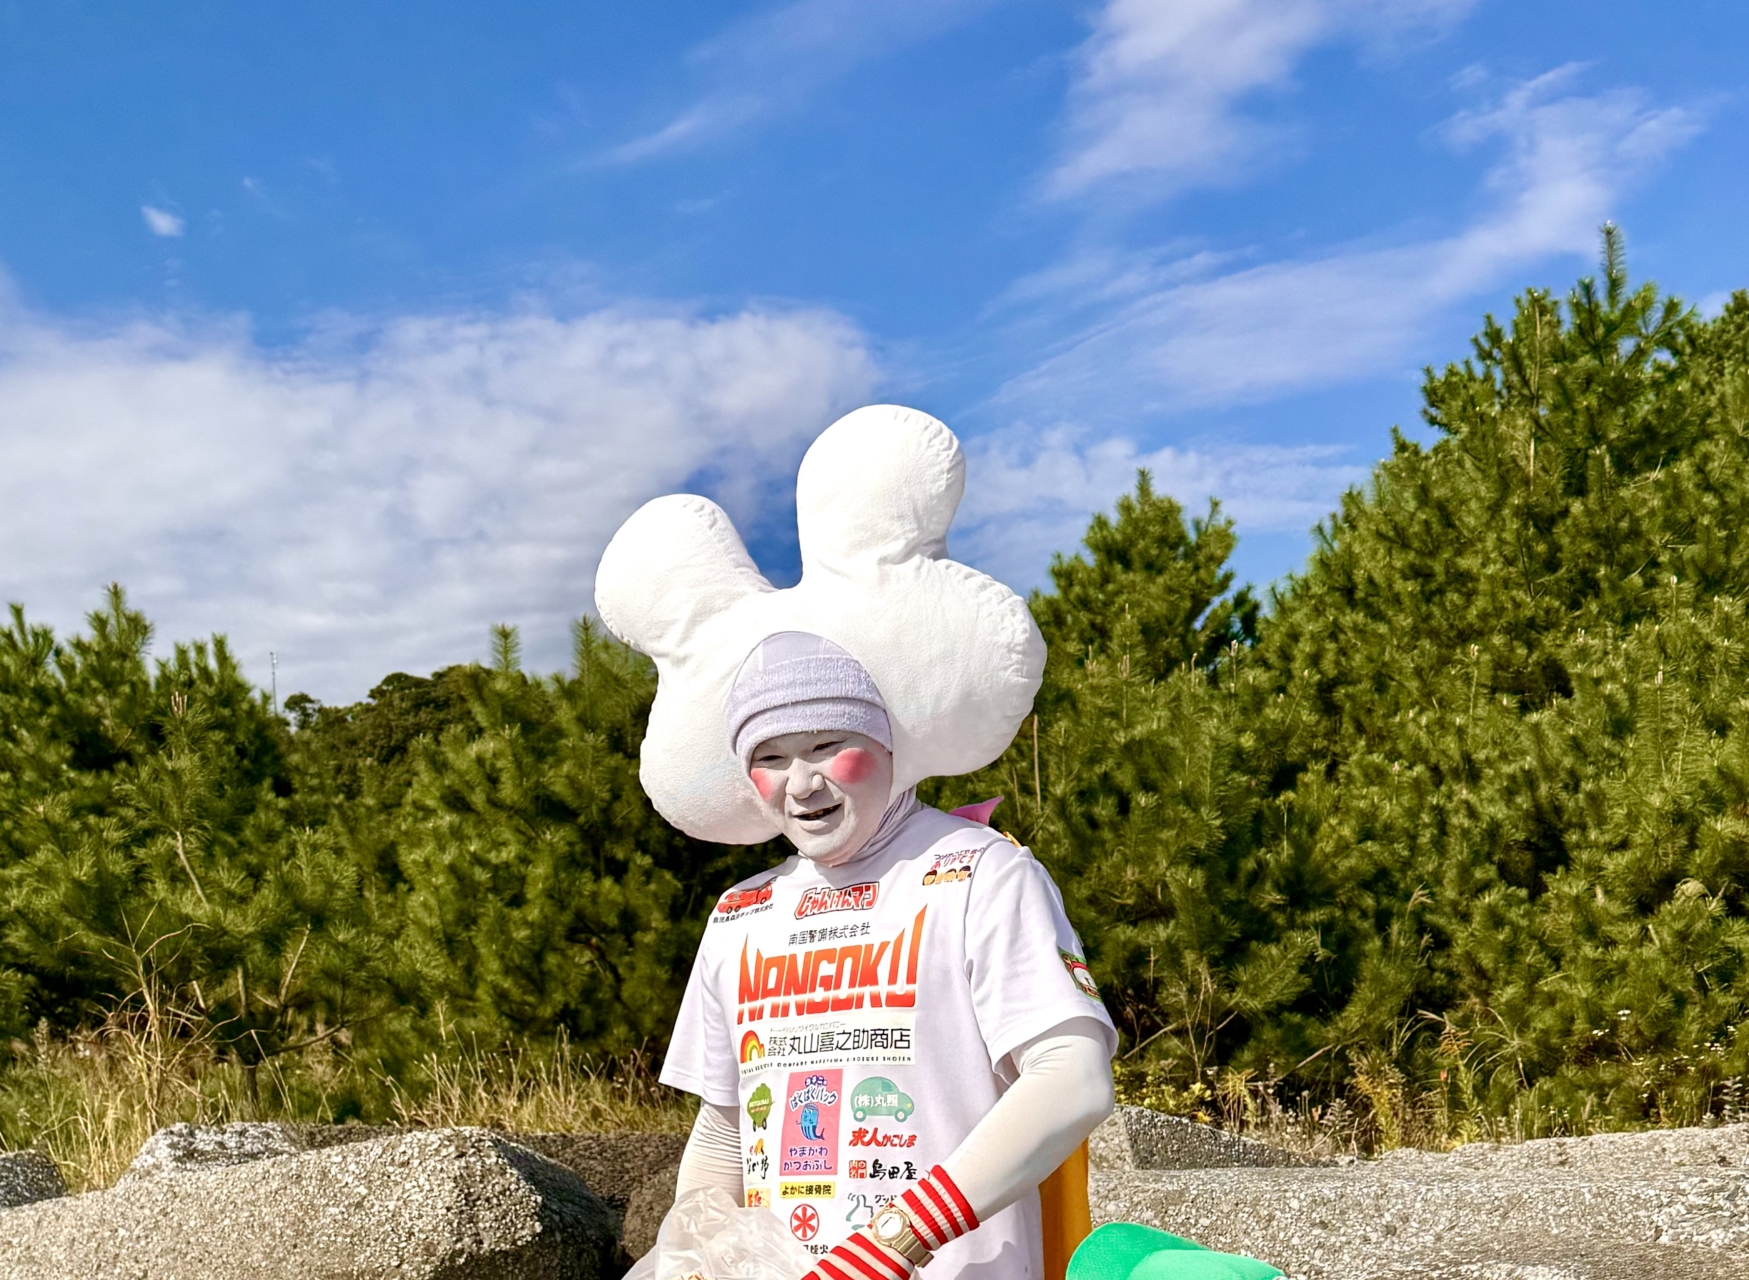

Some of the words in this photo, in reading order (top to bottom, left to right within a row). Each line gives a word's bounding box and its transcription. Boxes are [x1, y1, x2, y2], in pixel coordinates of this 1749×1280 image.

[795, 882, 880, 920] じゃんけんマン
[788, 922, 871, 947] 南国警備株式会社
[737, 903, 928, 1025] NANGOKU
[767, 1047, 787, 1057] 会社
[769, 1036, 788, 1047] 株式
[788, 1028, 911, 1056] 丸山喜之助商店
[790, 1085, 838, 1110] ぱくぱくパック
[849, 1127, 918, 1148] 求人かごしま
[789, 1146, 829, 1157] やまかわ
[783, 1159, 833, 1172] かつおぶし
[869, 1158, 918, 1181] 島田屋
[781, 1184, 833, 1196] よかに接骨院
